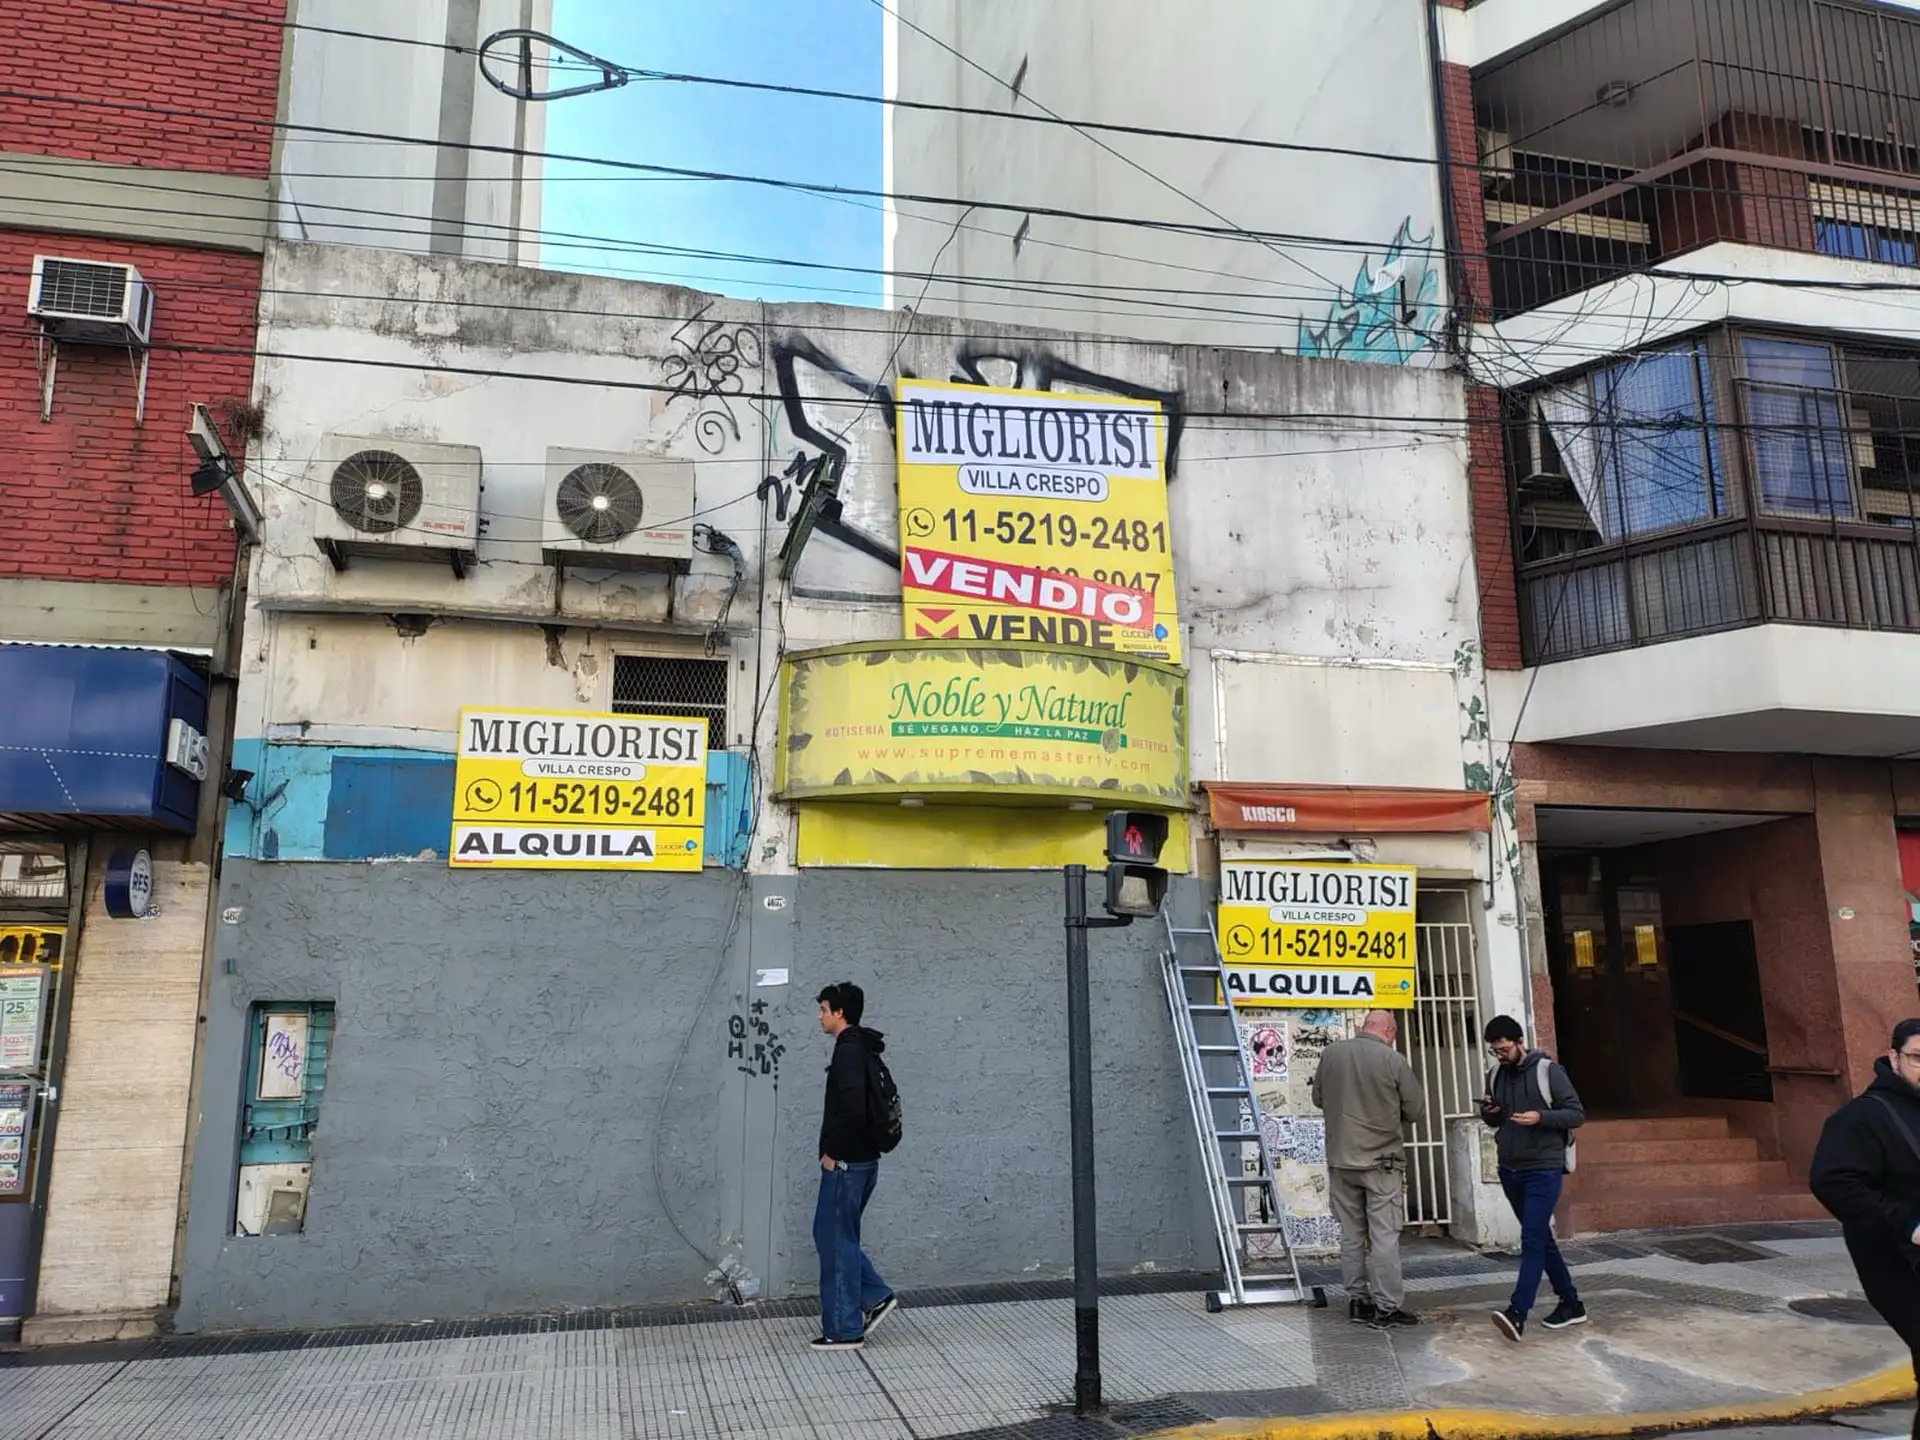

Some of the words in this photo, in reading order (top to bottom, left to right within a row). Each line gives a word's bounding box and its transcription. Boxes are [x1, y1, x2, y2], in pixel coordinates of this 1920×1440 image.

[910, 399, 1152, 469] MIGLIORISI
[968, 469, 1021, 490] VILLA
[1026, 473, 1101, 496] CRESPO
[942, 509, 1167, 553] 11-5219-2481
[968, 613, 1116, 648] VENDE
[888, 677, 985, 720] Noble
[987, 693, 1013, 733] y
[1016, 685, 1132, 729] Natural
[469, 718, 699, 761] MIGLIORISI
[1014, 726, 1041, 737] HAZ
[1046, 728, 1062, 738] LA
[1067, 730, 1089, 741] PAZ
[538, 763, 574, 775] VILLA
[578, 764, 631, 777] CRESPO
[858, 747, 1152, 773] www.suprememastertv.com
[509, 782, 695, 817] 11-5219-2481
[1241, 806, 1296, 823] KIOSCO
[458, 832, 654, 857] ALQUILA
[1227, 870, 1409, 907] MIGLIORISI
[1282, 911, 1311, 921] VILLA
[1313, 911, 1356, 922] CRESPO
[1260, 927, 1407, 959] 11-5219-2481
[1227, 972, 1374, 996] ALQUILA
